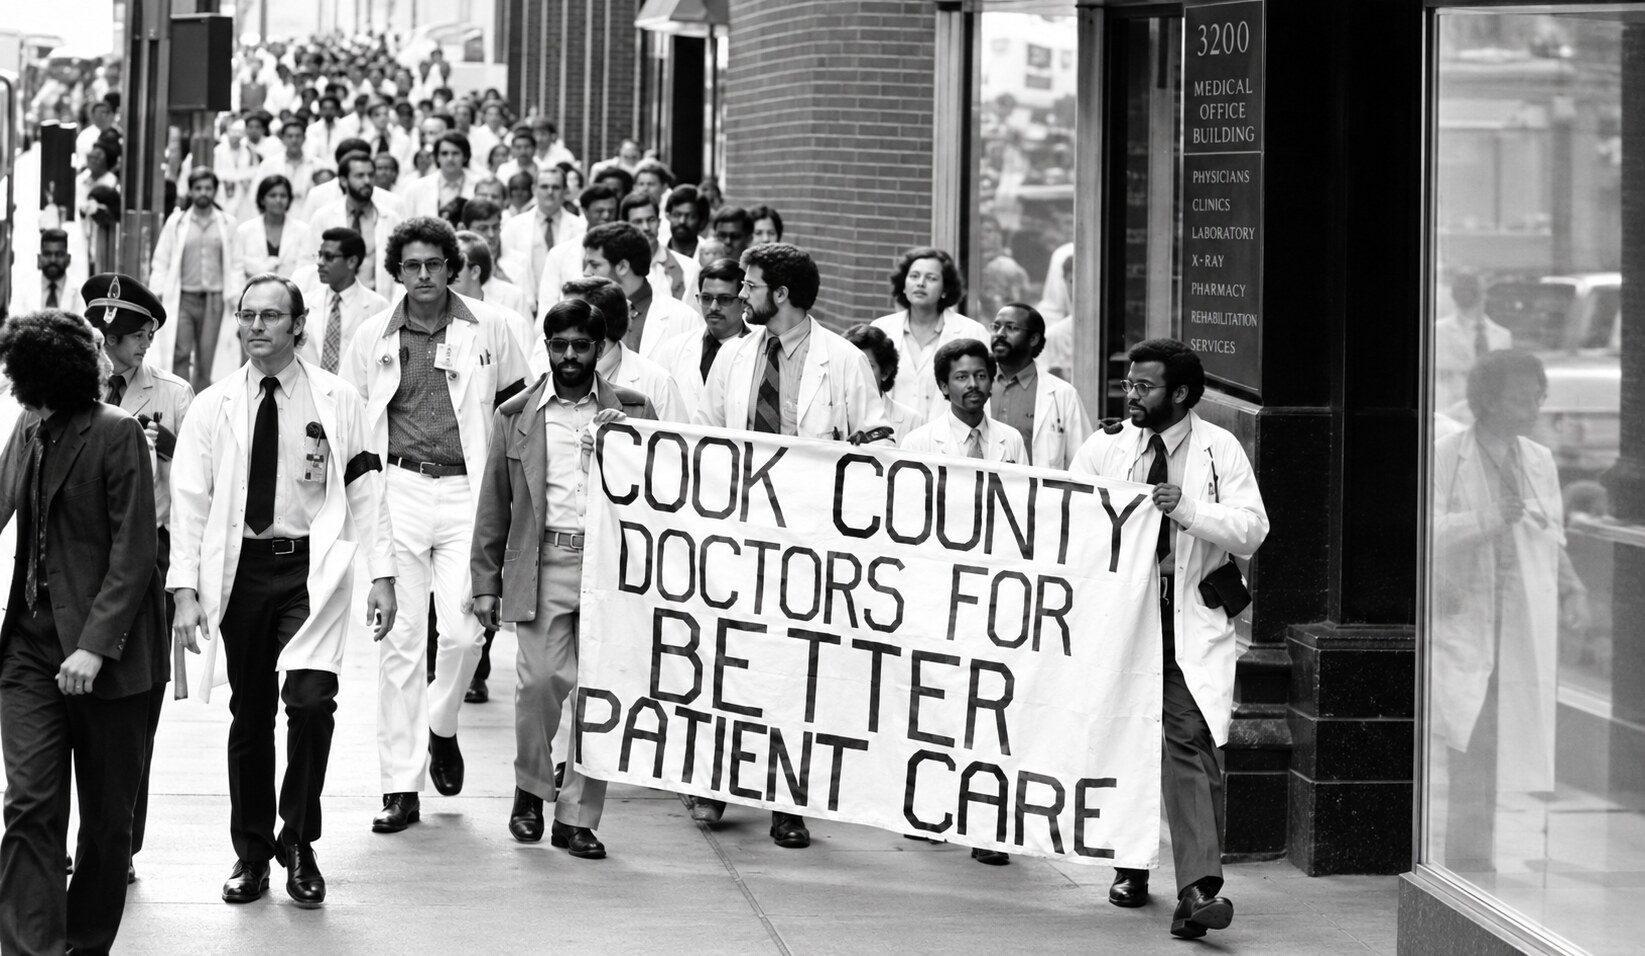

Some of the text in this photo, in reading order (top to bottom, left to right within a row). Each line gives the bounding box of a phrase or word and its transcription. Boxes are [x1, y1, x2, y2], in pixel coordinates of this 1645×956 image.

[1197, 21, 1249, 56] 3200
[1194, 78, 1253, 96] MEDICAL
[1199, 102, 1246, 120] OFFICE
[1193, 126, 1255, 143] BUILDING
[1192, 170, 1250, 184] PHYSICIANS
[1192, 198, 1231, 212] CLINICS
[1191, 226, 1255, 240] LABORATORY
[1191, 254, 1225, 268] X-RAY
[1191, 282, 1246, 297] PHARMACY
[1191, 310, 1258, 327] REHABILITATION
[1190, 338, 1236, 354] SERVICES
[599, 423, 1148, 573] COOK COUNTY
[618, 519, 1073, 656] DOCTORS FOR
[649, 607, 1015, 756] BETTER
[575, 686, 1117, 859] PATIENT CARE
